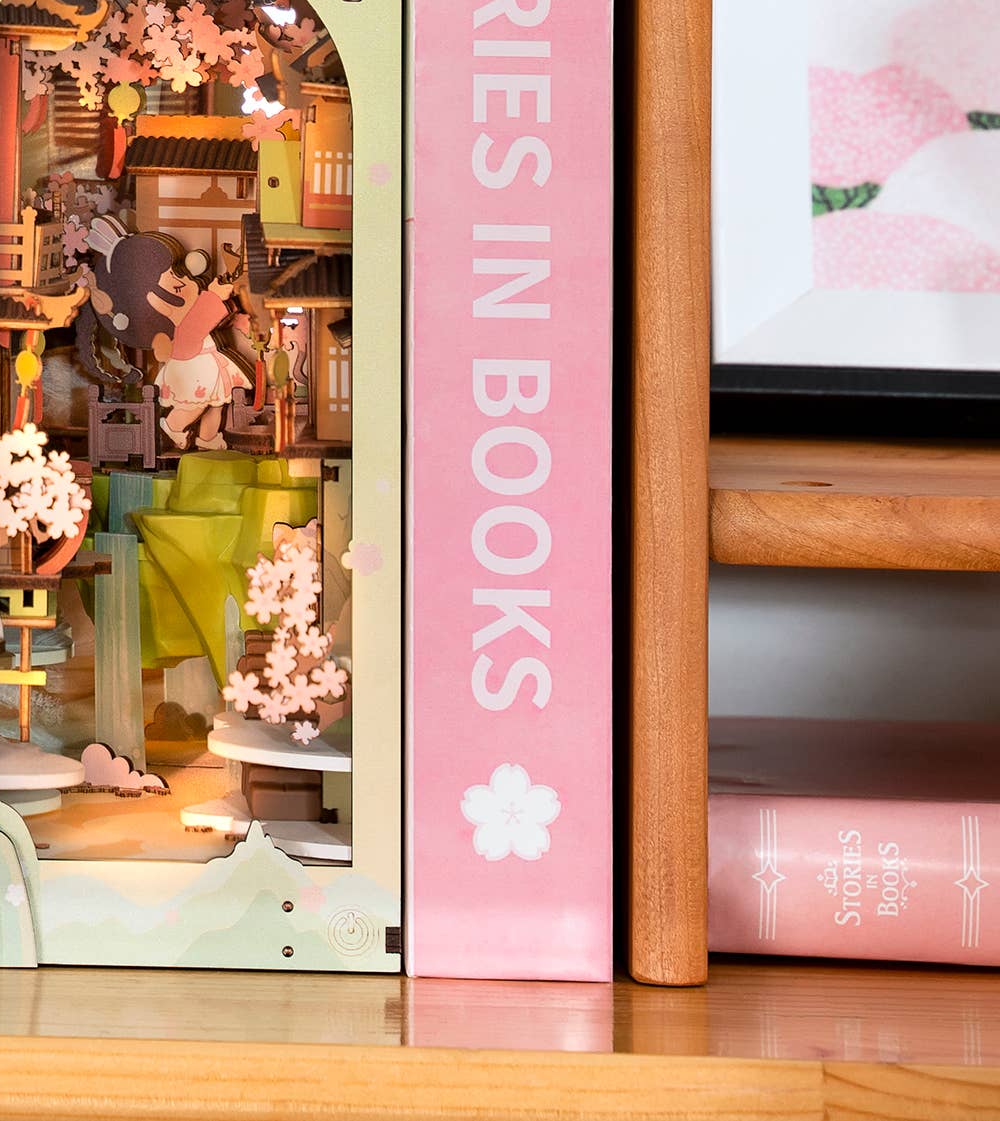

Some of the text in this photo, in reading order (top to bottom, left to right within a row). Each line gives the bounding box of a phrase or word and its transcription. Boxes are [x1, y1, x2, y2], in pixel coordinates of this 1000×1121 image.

[472, 224, 551, 319] IN
[471, 358, 552, 711] BOOKS
[835, 829, 861, 926] STORIES
[866, 874, 878, 889] IN
[877, 841, 899, 916] BOOKS
